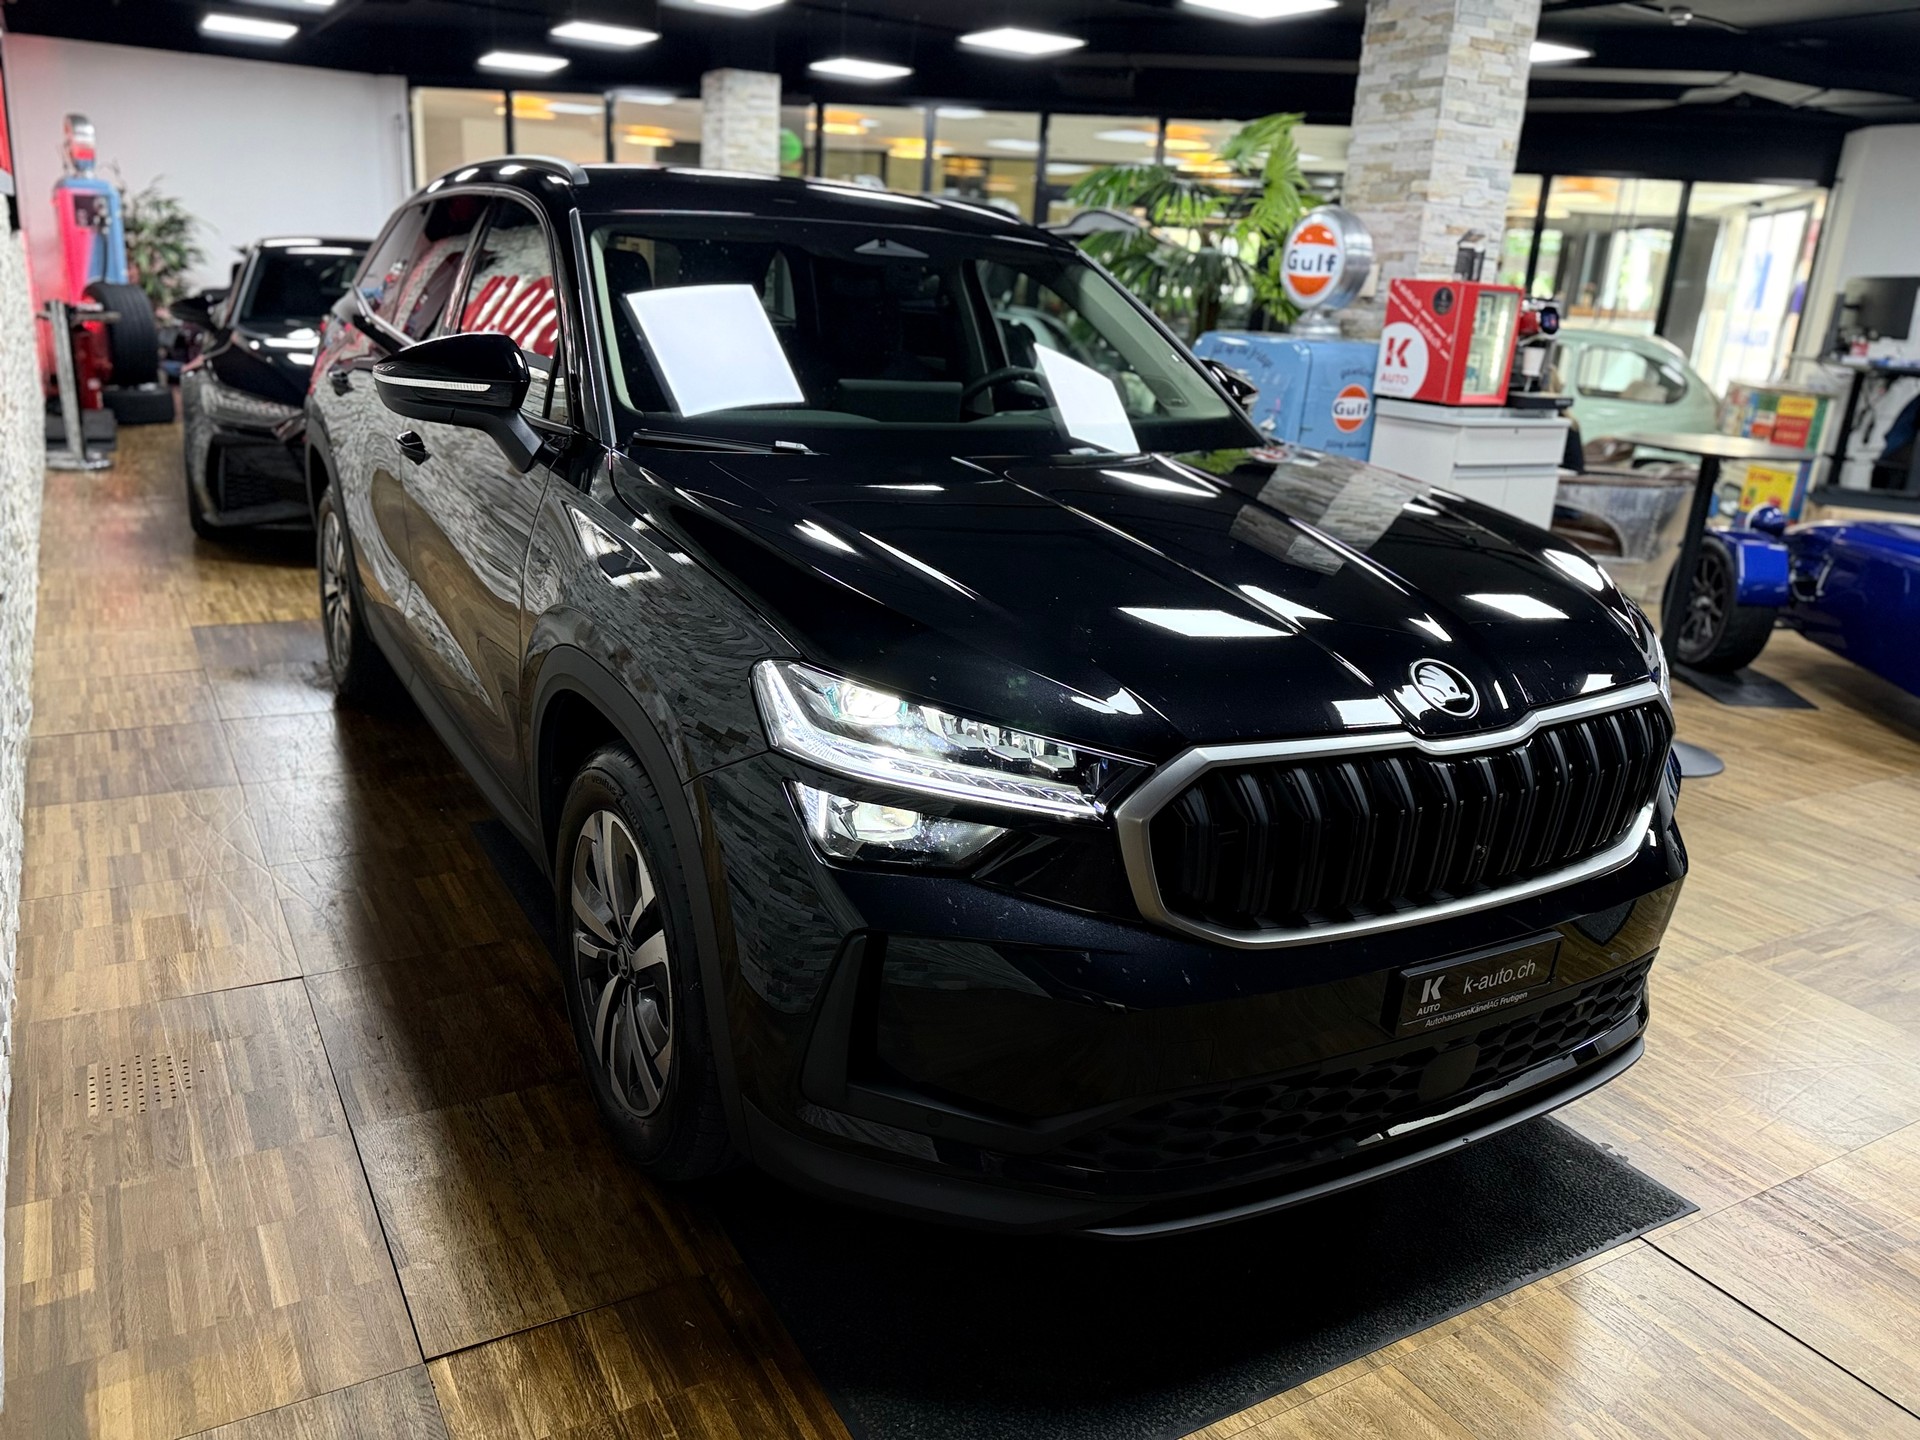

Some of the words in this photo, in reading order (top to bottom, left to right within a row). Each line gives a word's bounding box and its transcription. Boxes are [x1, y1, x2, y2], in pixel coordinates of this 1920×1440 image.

[1287, 249, 1337, 273] Gulf
[1385, 336, 1412, 369] K
[1380, 372, 1410, 386] AUTO
[1333, 401, 1369, 417] Gulf
[1462, 958, 1536, 995] k-auto.ch
[1420, 974, 1446, 1004] K
[1500, 991, 1528, 1006] Frutigen
[1416, 1002, 1441, 1017] AUTO
